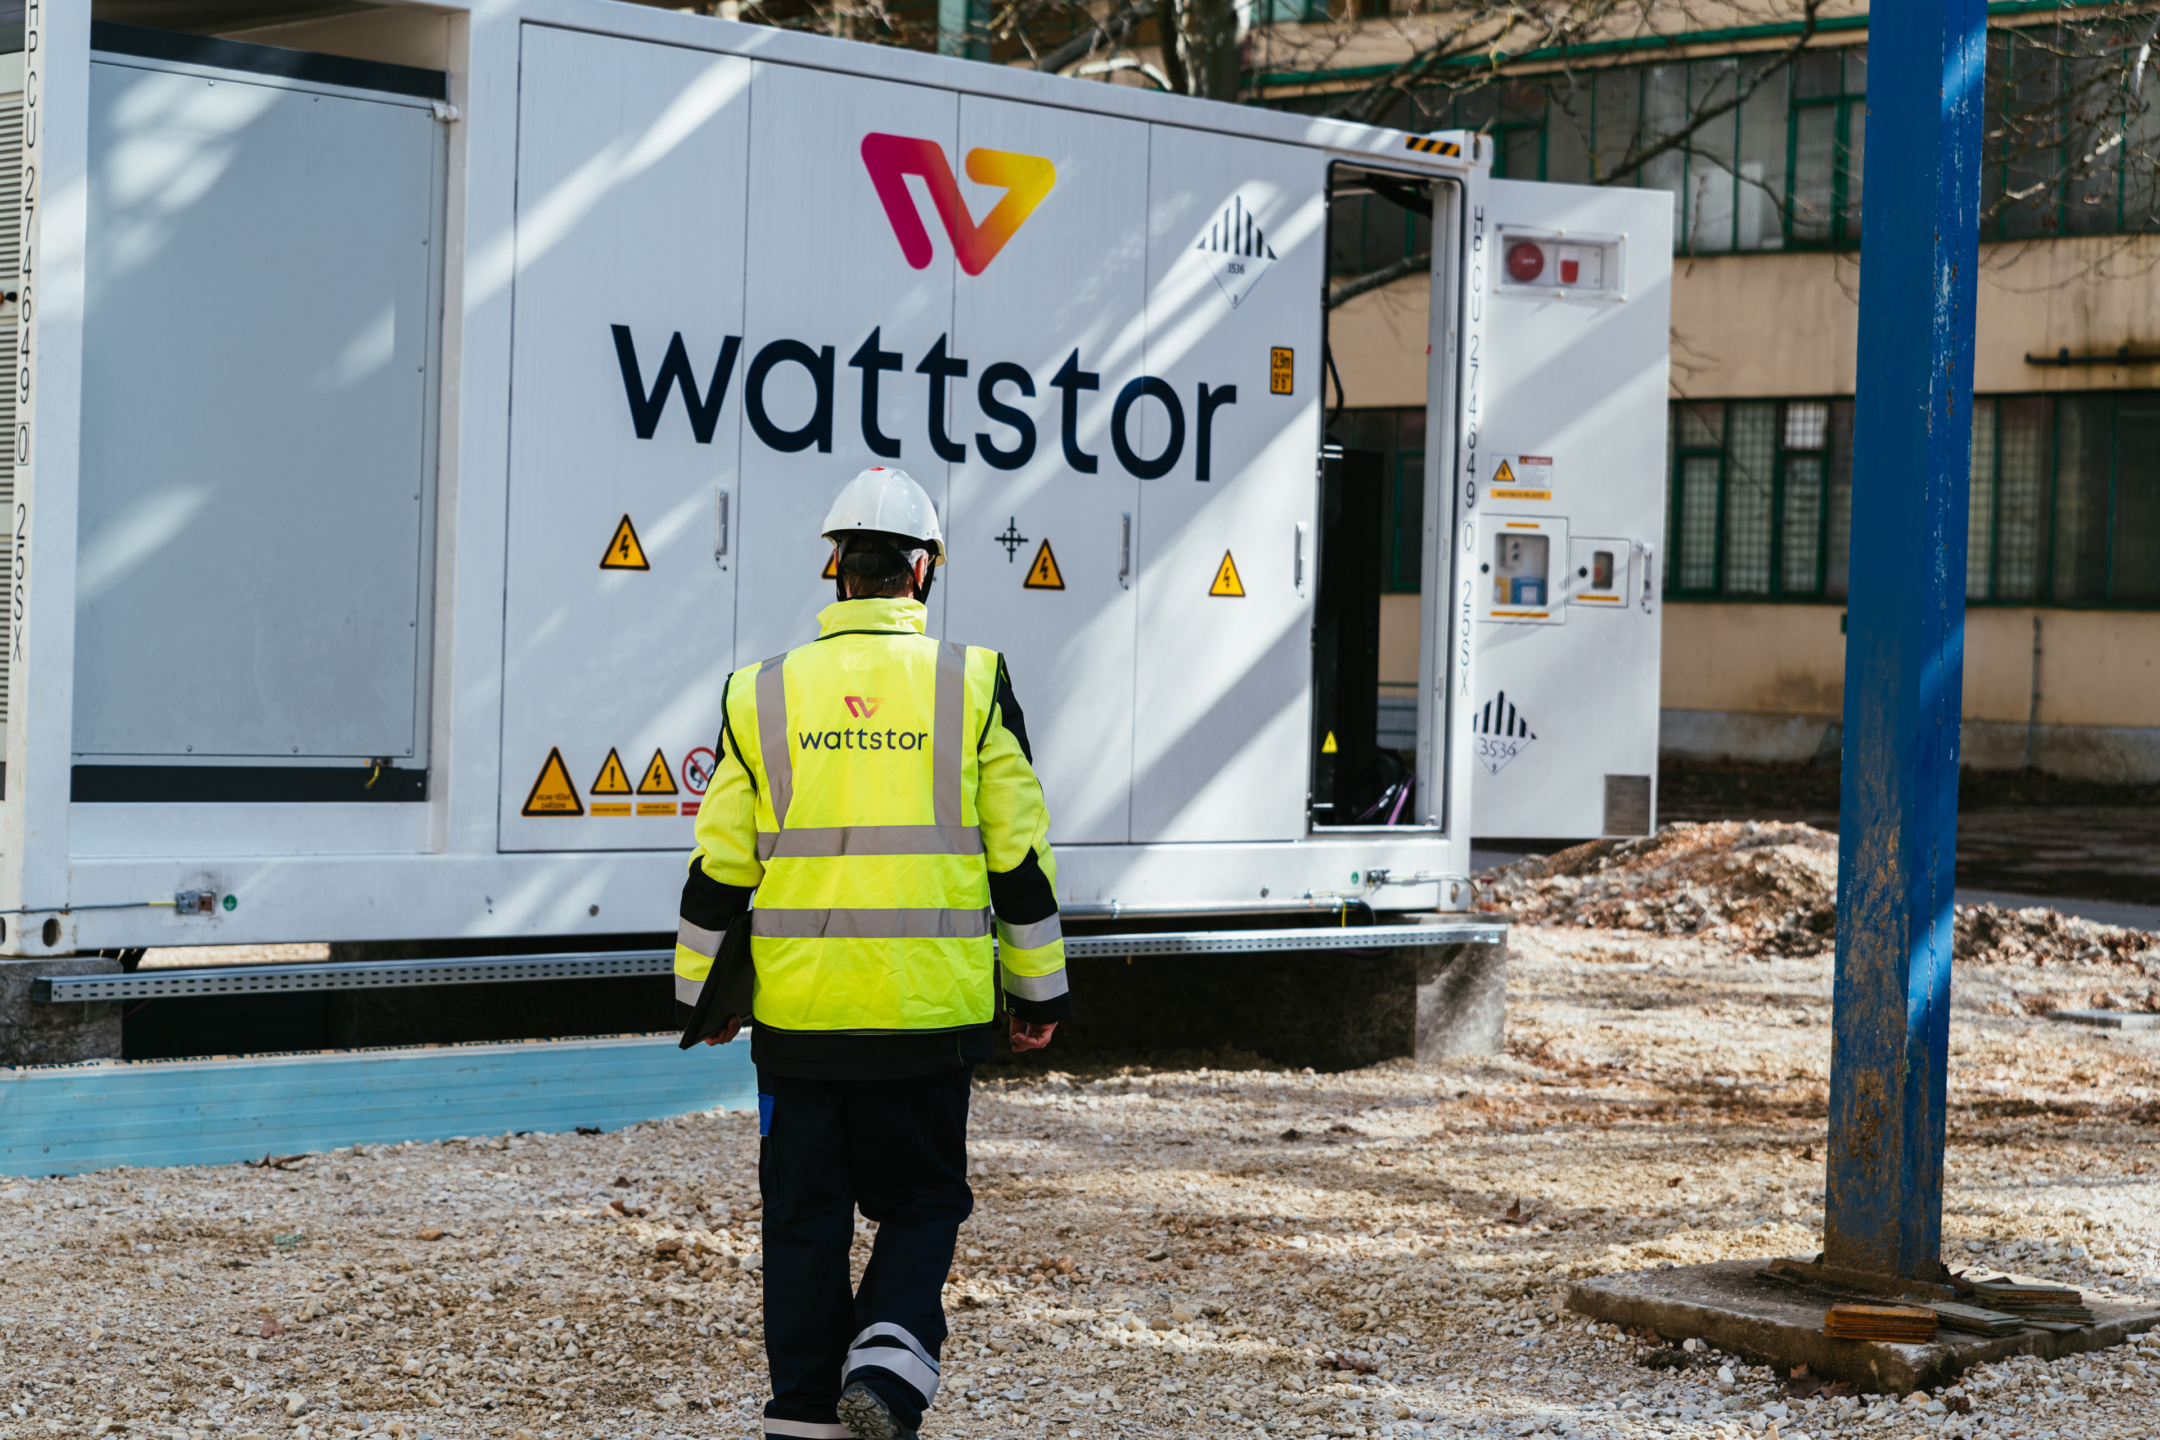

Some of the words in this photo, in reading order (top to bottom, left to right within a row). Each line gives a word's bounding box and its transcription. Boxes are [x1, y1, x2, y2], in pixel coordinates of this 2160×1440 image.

[26, 0, 39, 149] HPCU
[19, 166, 36, 406] 274649
[1227, 262, 1245, 275] 3536
[1472, 204, 1484, 322] HPCU
[610, 324, 1237, 482] wattstor
[1465, 334, 1480, 510] 274649
[798, 727, 928, 750] wattstor
[1478, 737, 1517, 759] 3536
